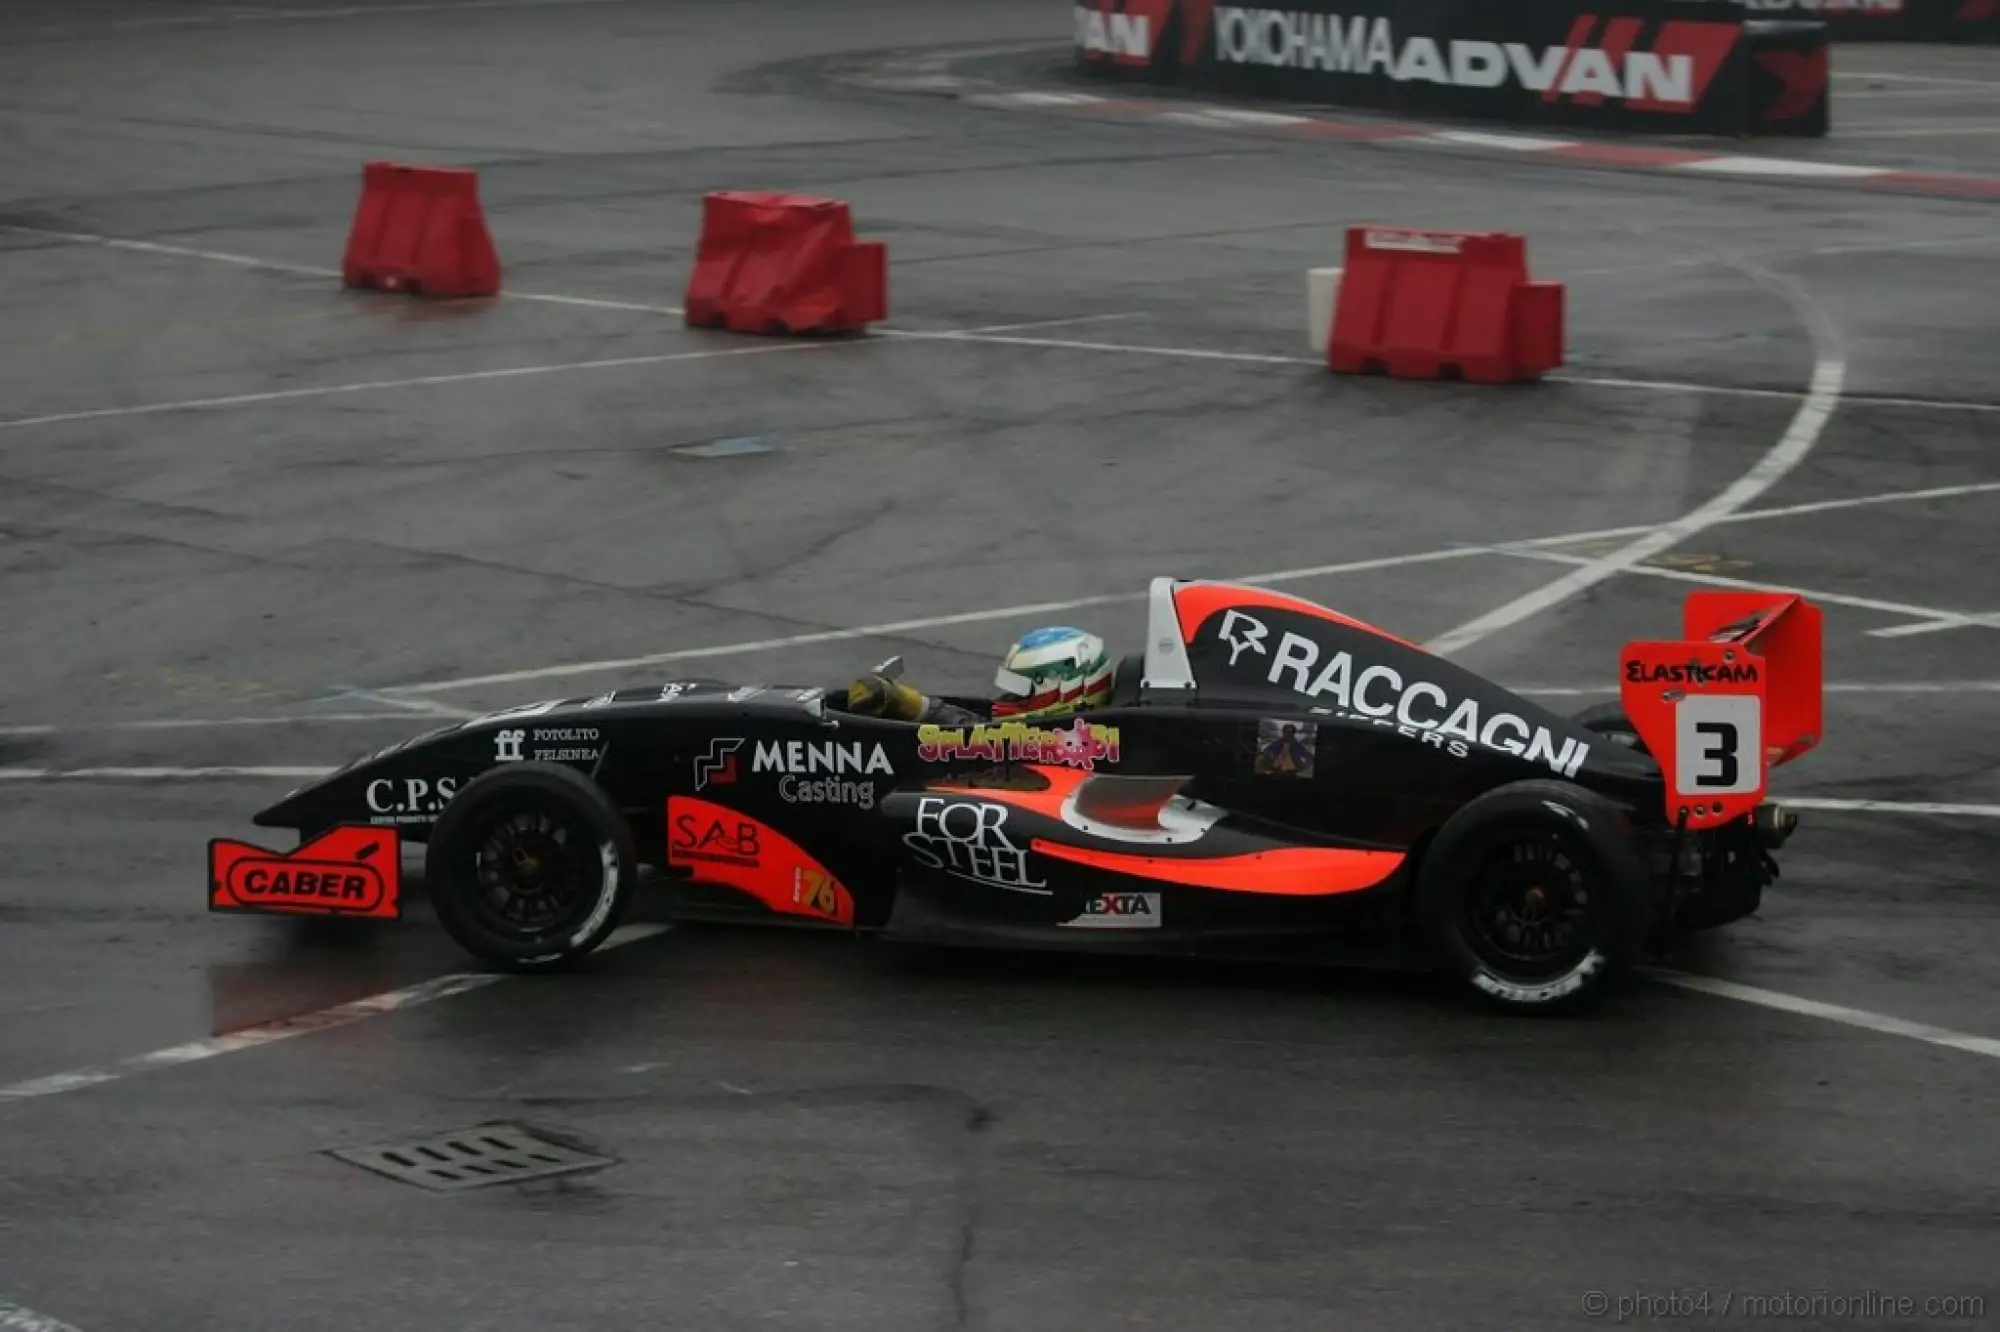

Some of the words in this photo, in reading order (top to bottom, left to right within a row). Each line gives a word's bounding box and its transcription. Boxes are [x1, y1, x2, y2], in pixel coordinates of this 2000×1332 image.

[1213, 6, 1397, 76] YOKOHAMA
[1393, 36, 1693, 101] ADVAN
[1268, 631, 1590, 778] RACCAGNI
[494, 729, 526, 761] ff
[752, 739, 893, 775] MENNA
[1695, 722, 1738, 787] 3
[779, 774, 873, 810] Casting
[672, 814, 760, 856] SAB
[916, 798, 1015, 853] FOR
[244, 869, 366, 900] CABER
[902, 832, 1047, 890] STEEL
